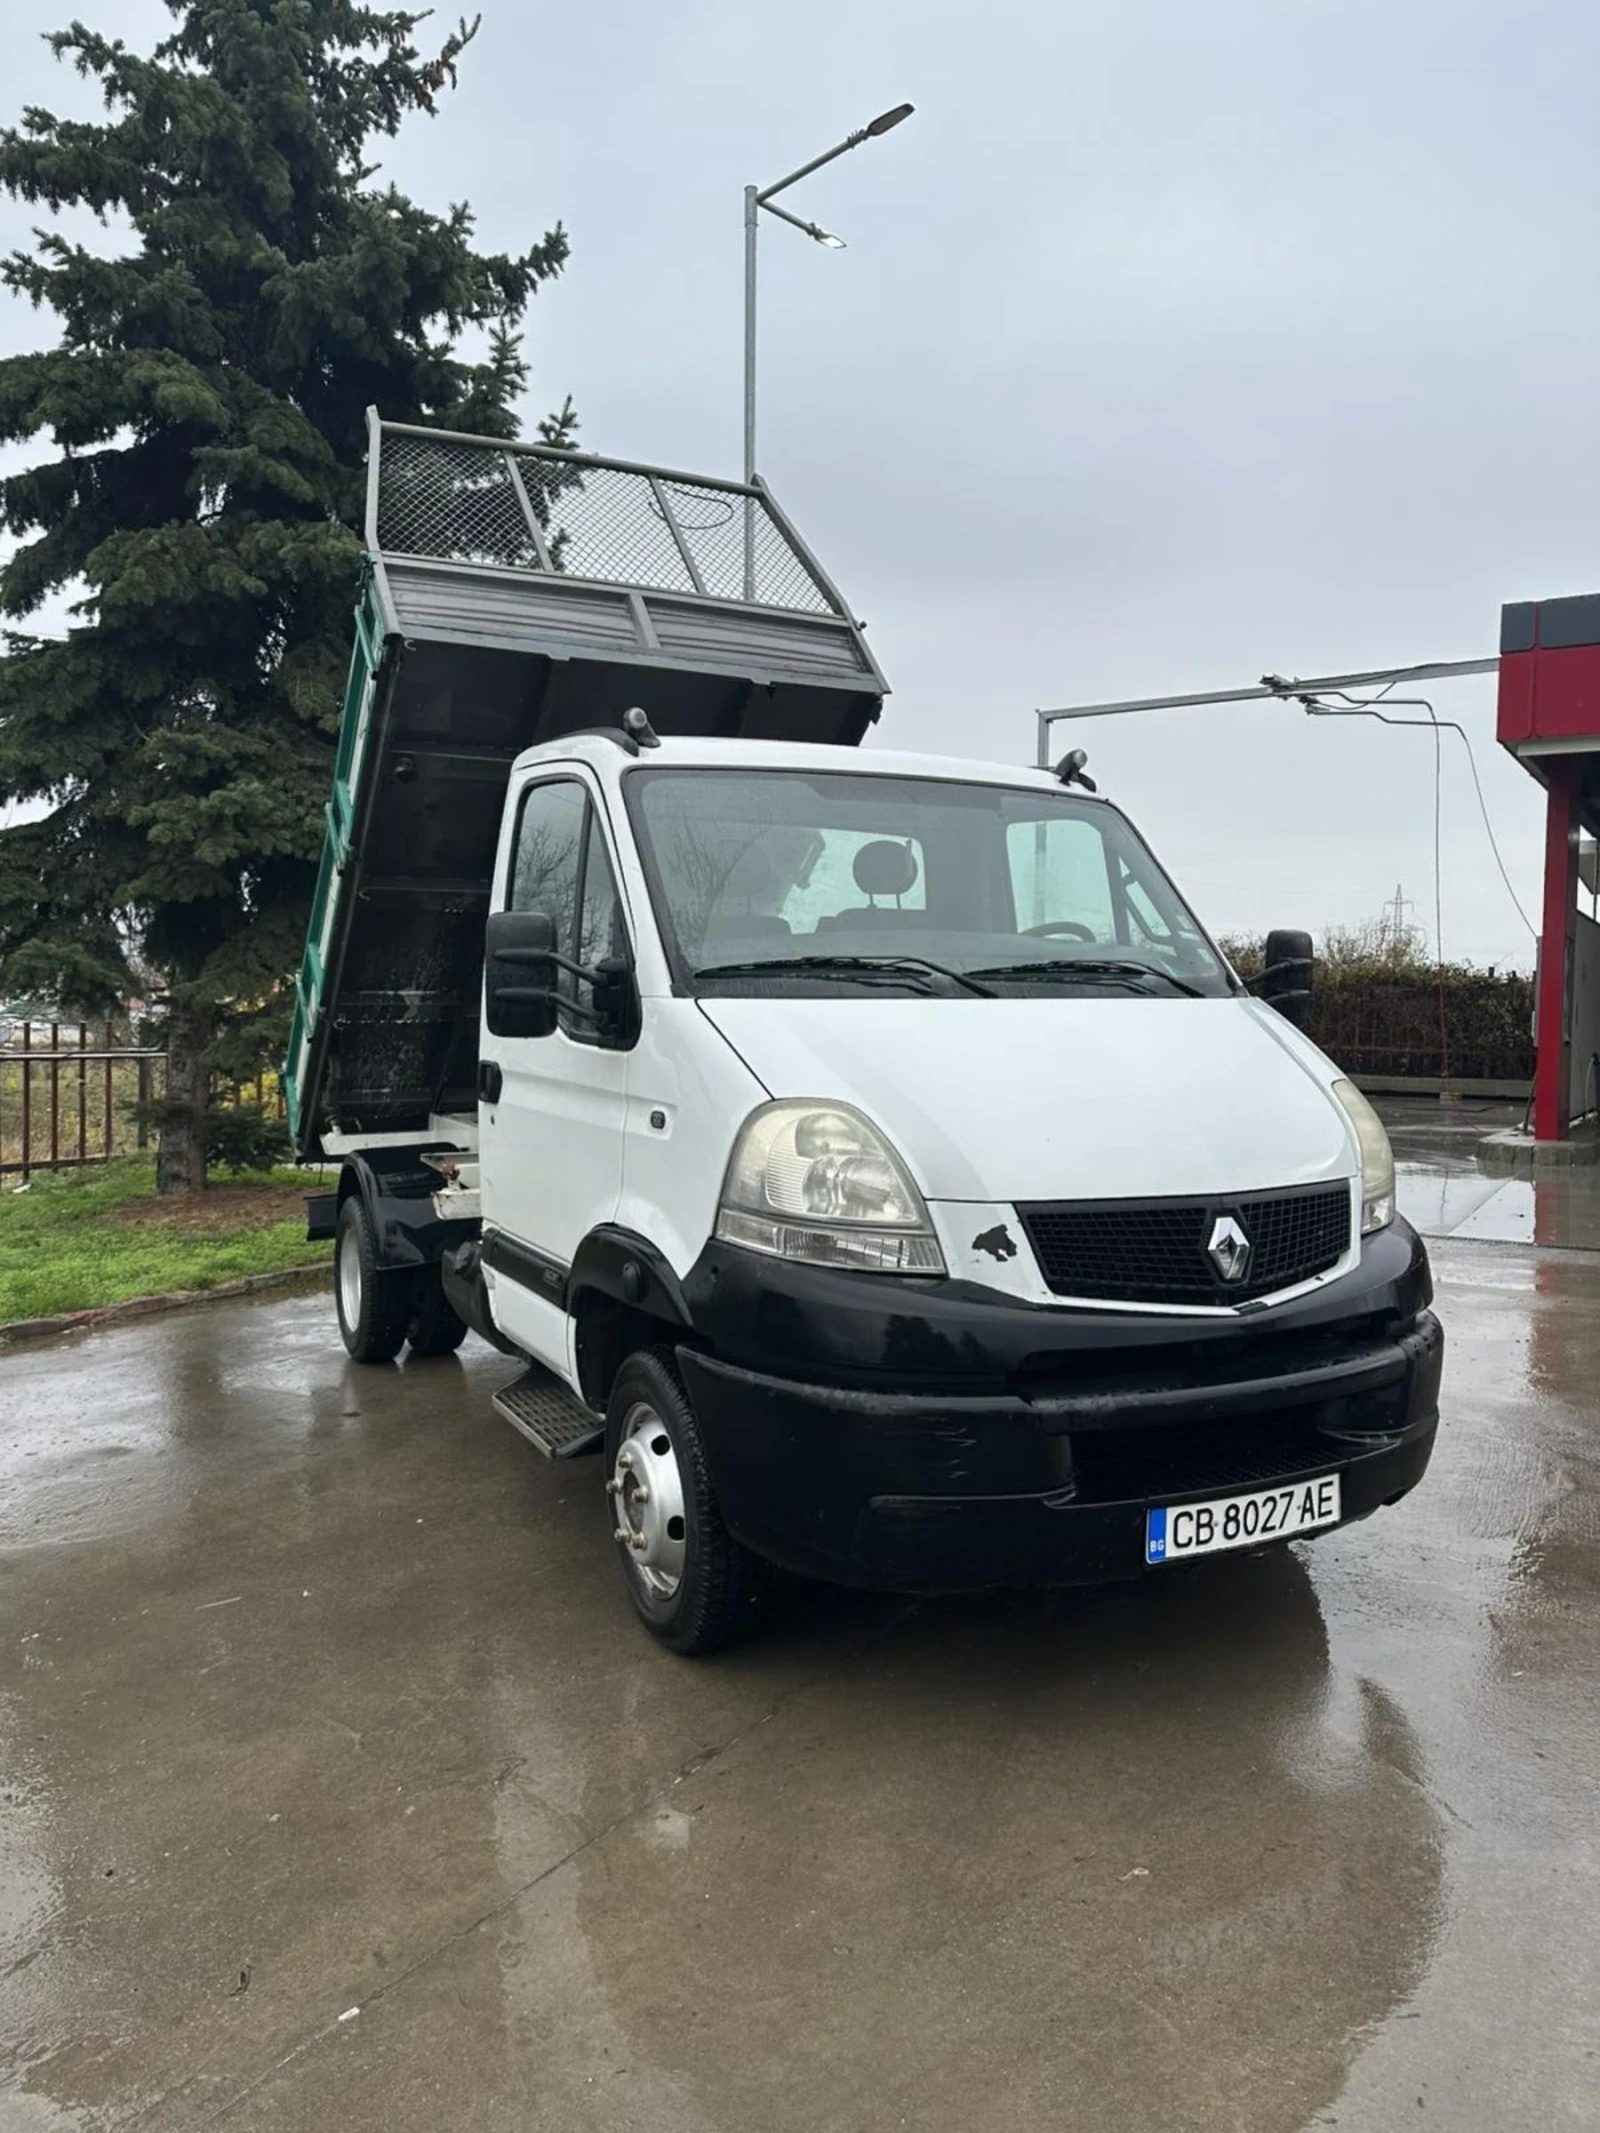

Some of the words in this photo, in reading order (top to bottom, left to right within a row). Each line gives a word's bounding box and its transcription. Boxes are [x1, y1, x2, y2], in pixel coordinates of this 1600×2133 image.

[1173, 1508, 1214, 1549] CB
[1223, 1491, 1295, 1540] 8027
[1299, 1481, 1334, 1524] AE
[1150, 1540, 1164, 1552] BG
